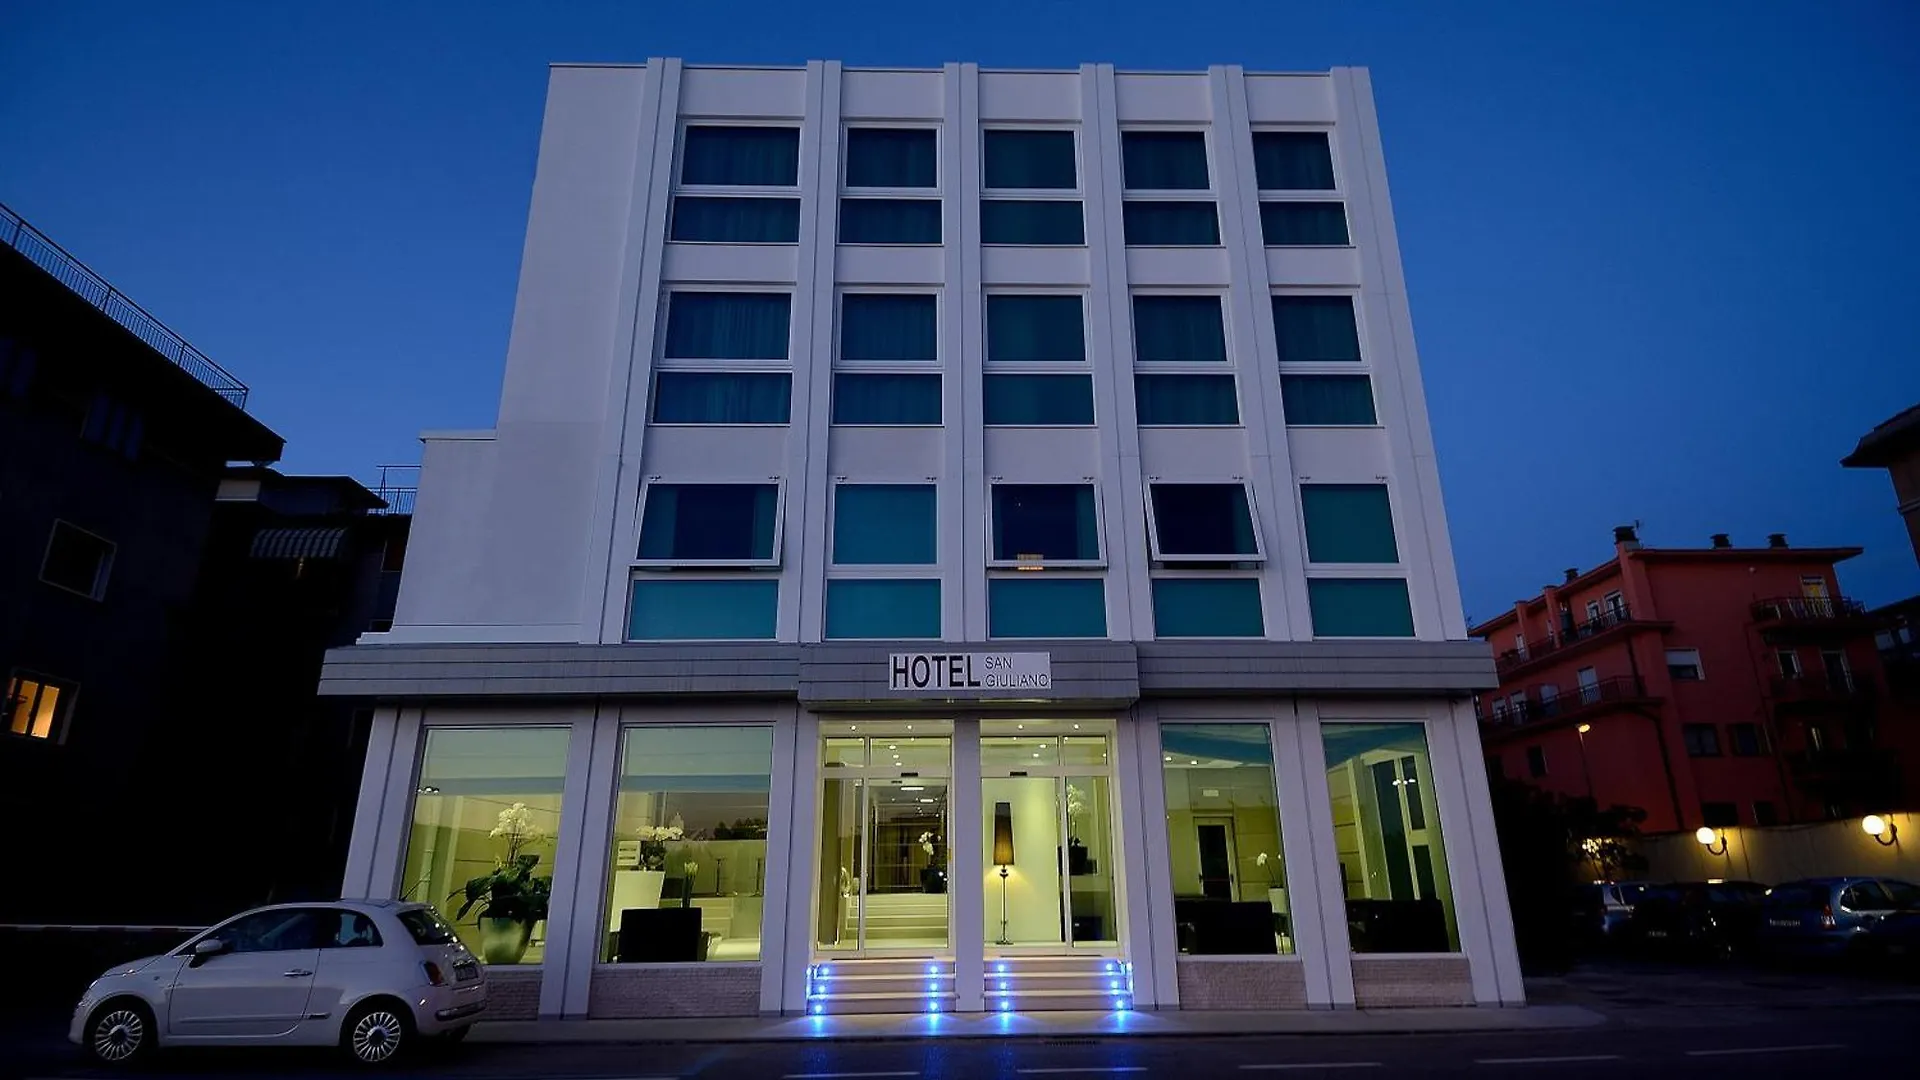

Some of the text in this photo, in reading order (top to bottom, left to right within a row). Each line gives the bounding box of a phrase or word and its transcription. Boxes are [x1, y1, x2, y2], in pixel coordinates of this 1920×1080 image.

[985, 656, 1012, 669] SAN
[893, 655, 980, 688] HOTEL
[985, 673, 1048, 687] GIULIANO
